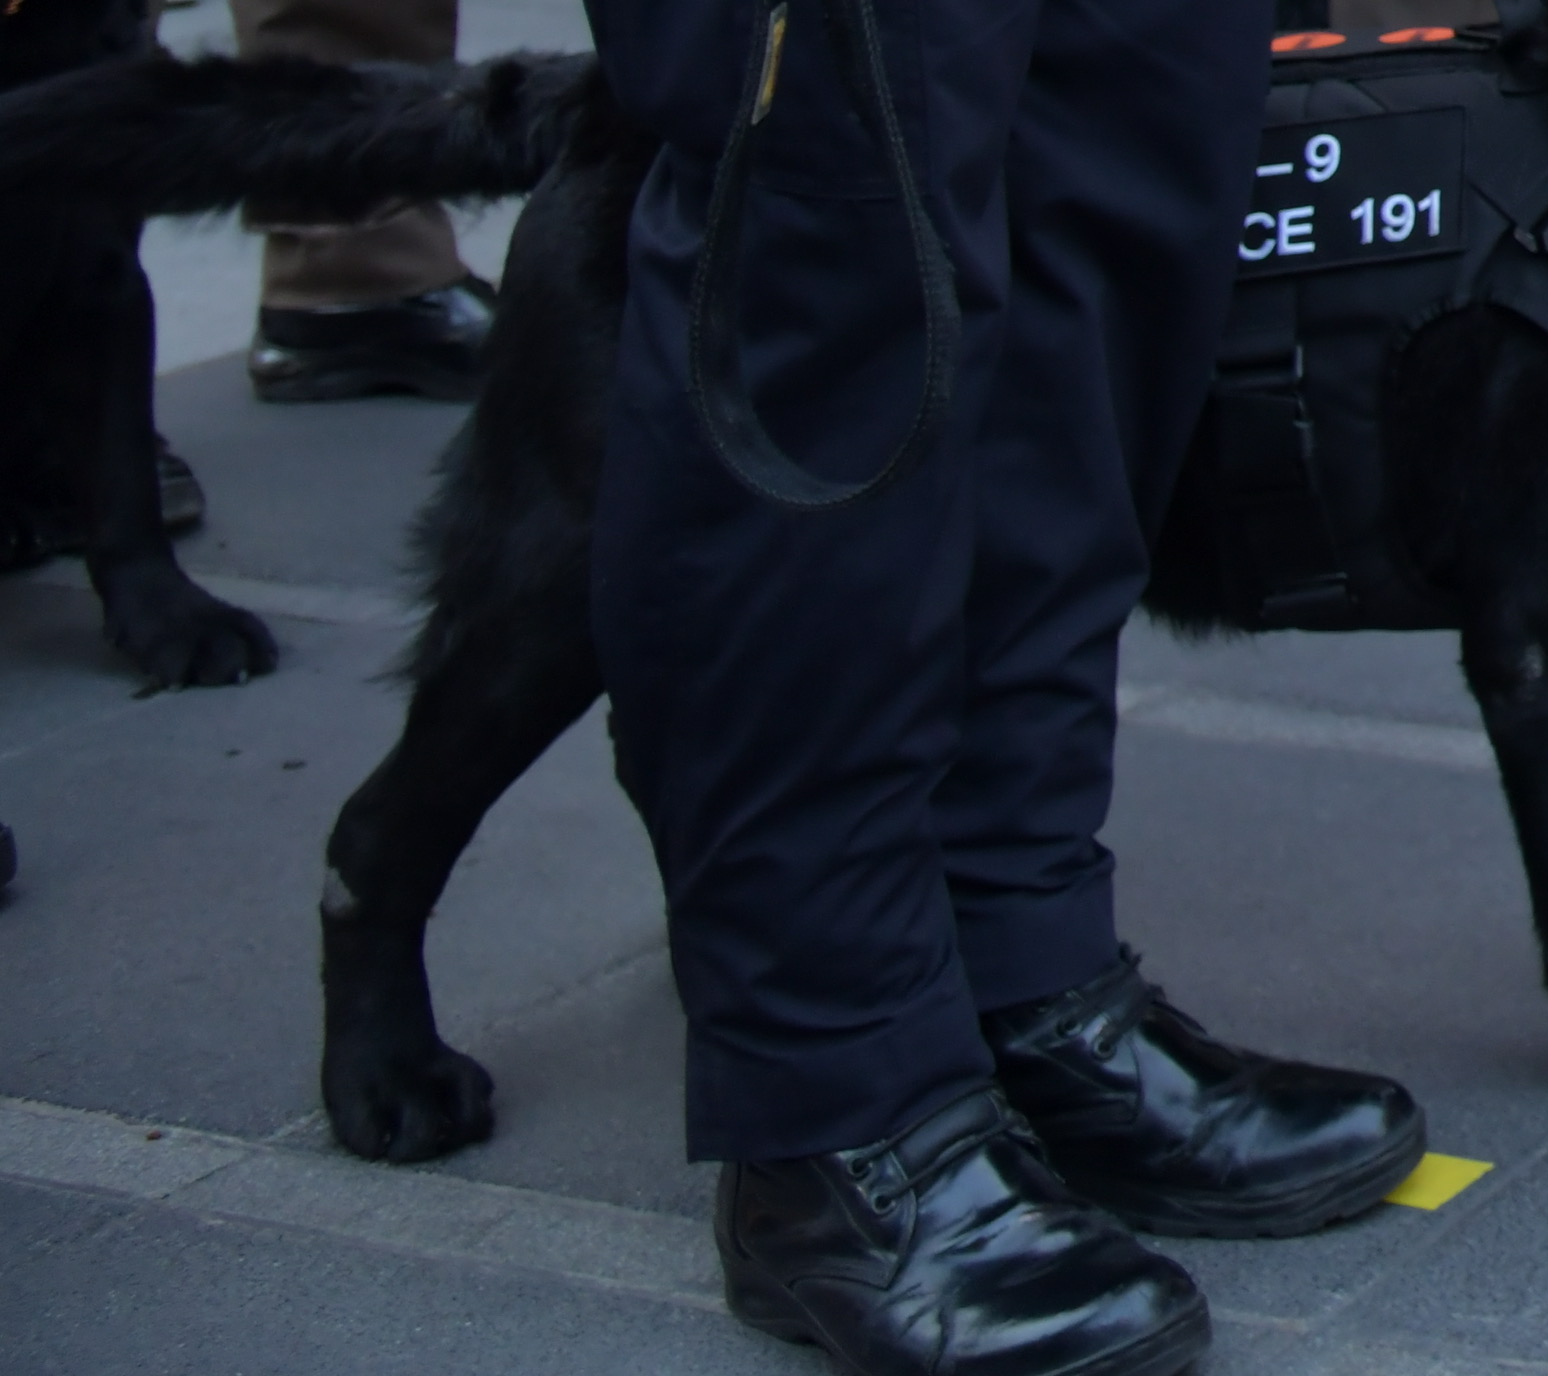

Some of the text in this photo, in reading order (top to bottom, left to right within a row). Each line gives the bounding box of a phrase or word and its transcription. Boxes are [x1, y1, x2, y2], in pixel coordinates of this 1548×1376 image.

[1256, 133, 1341, 183] -9
[1238, 189, 1441, 262] CE 191
